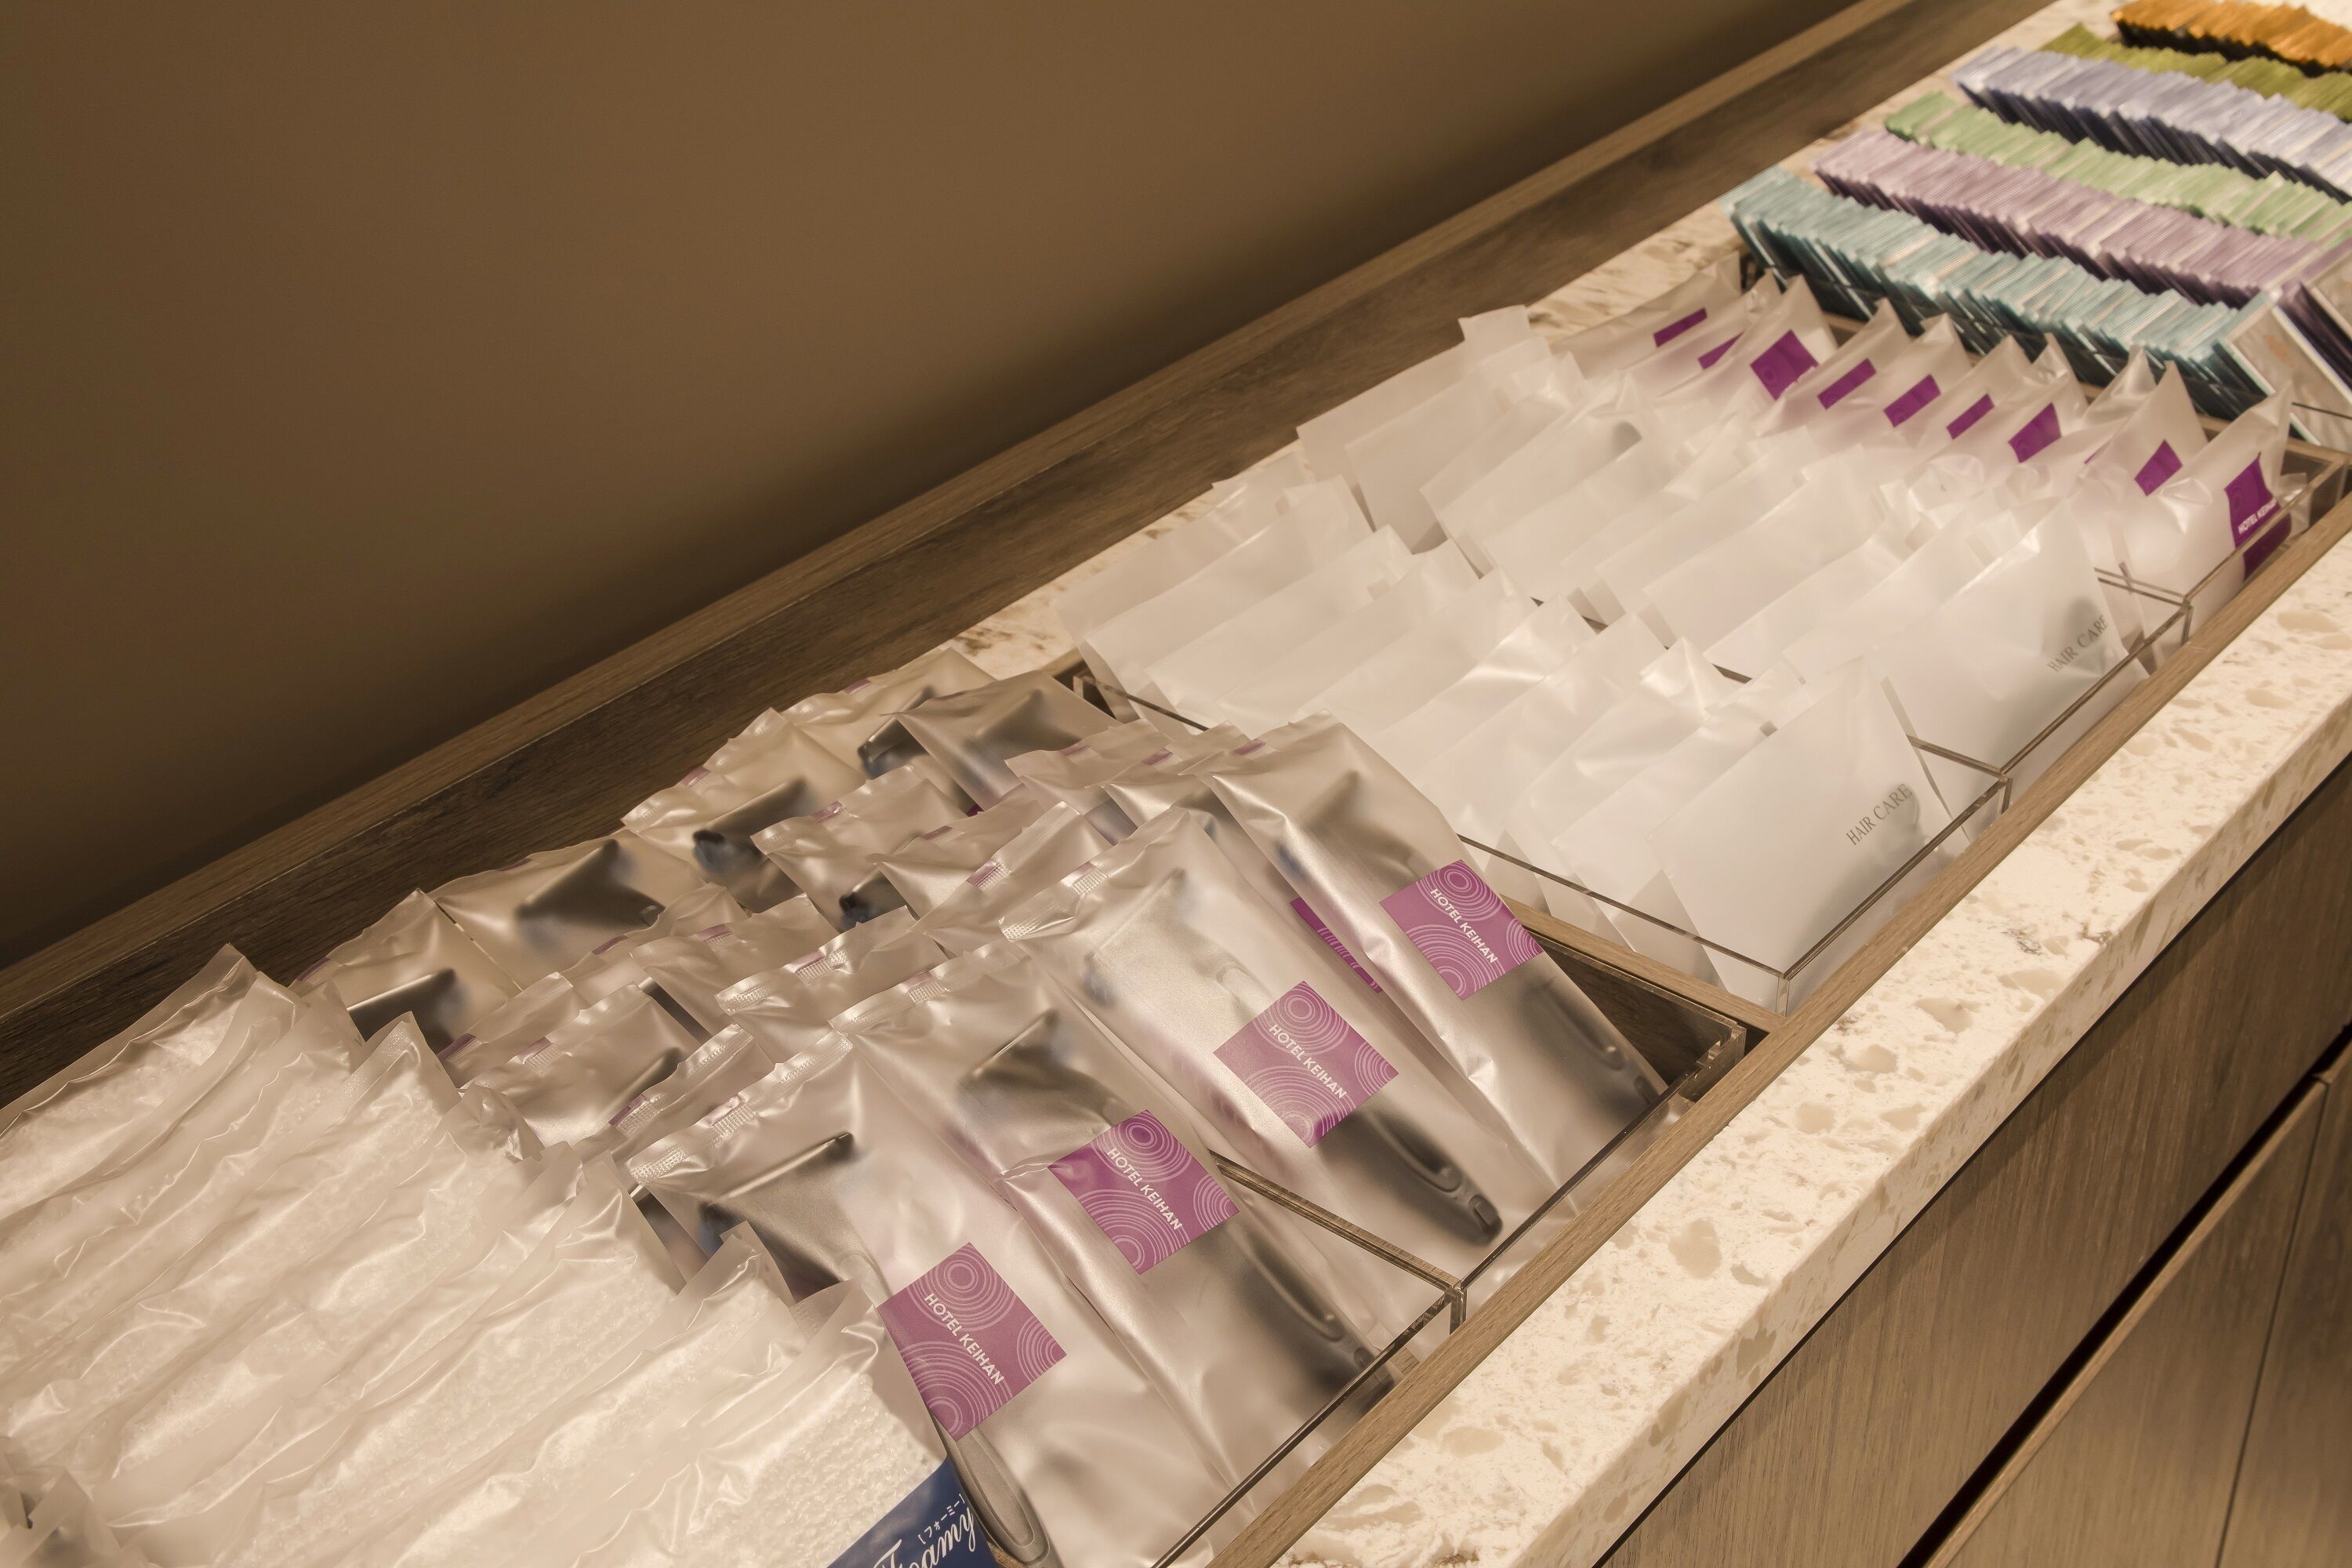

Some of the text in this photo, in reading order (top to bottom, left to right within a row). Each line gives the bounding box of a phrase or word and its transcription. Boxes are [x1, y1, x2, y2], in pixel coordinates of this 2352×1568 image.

[2046, 614, 2109, 672] HAIR CARE
[1846, 782, 1913, 846] HAIR CARE
[1429, 887, 1498, 964] HOTEL KEIHAN
[1269, 1023, 1347, 1099] HOTEL KEIHAN
[1106, 1147, 1183, 1230] HOTEL KEIHAN
[924, 1292, 1005, 1385] HOTEL KEIHAN
